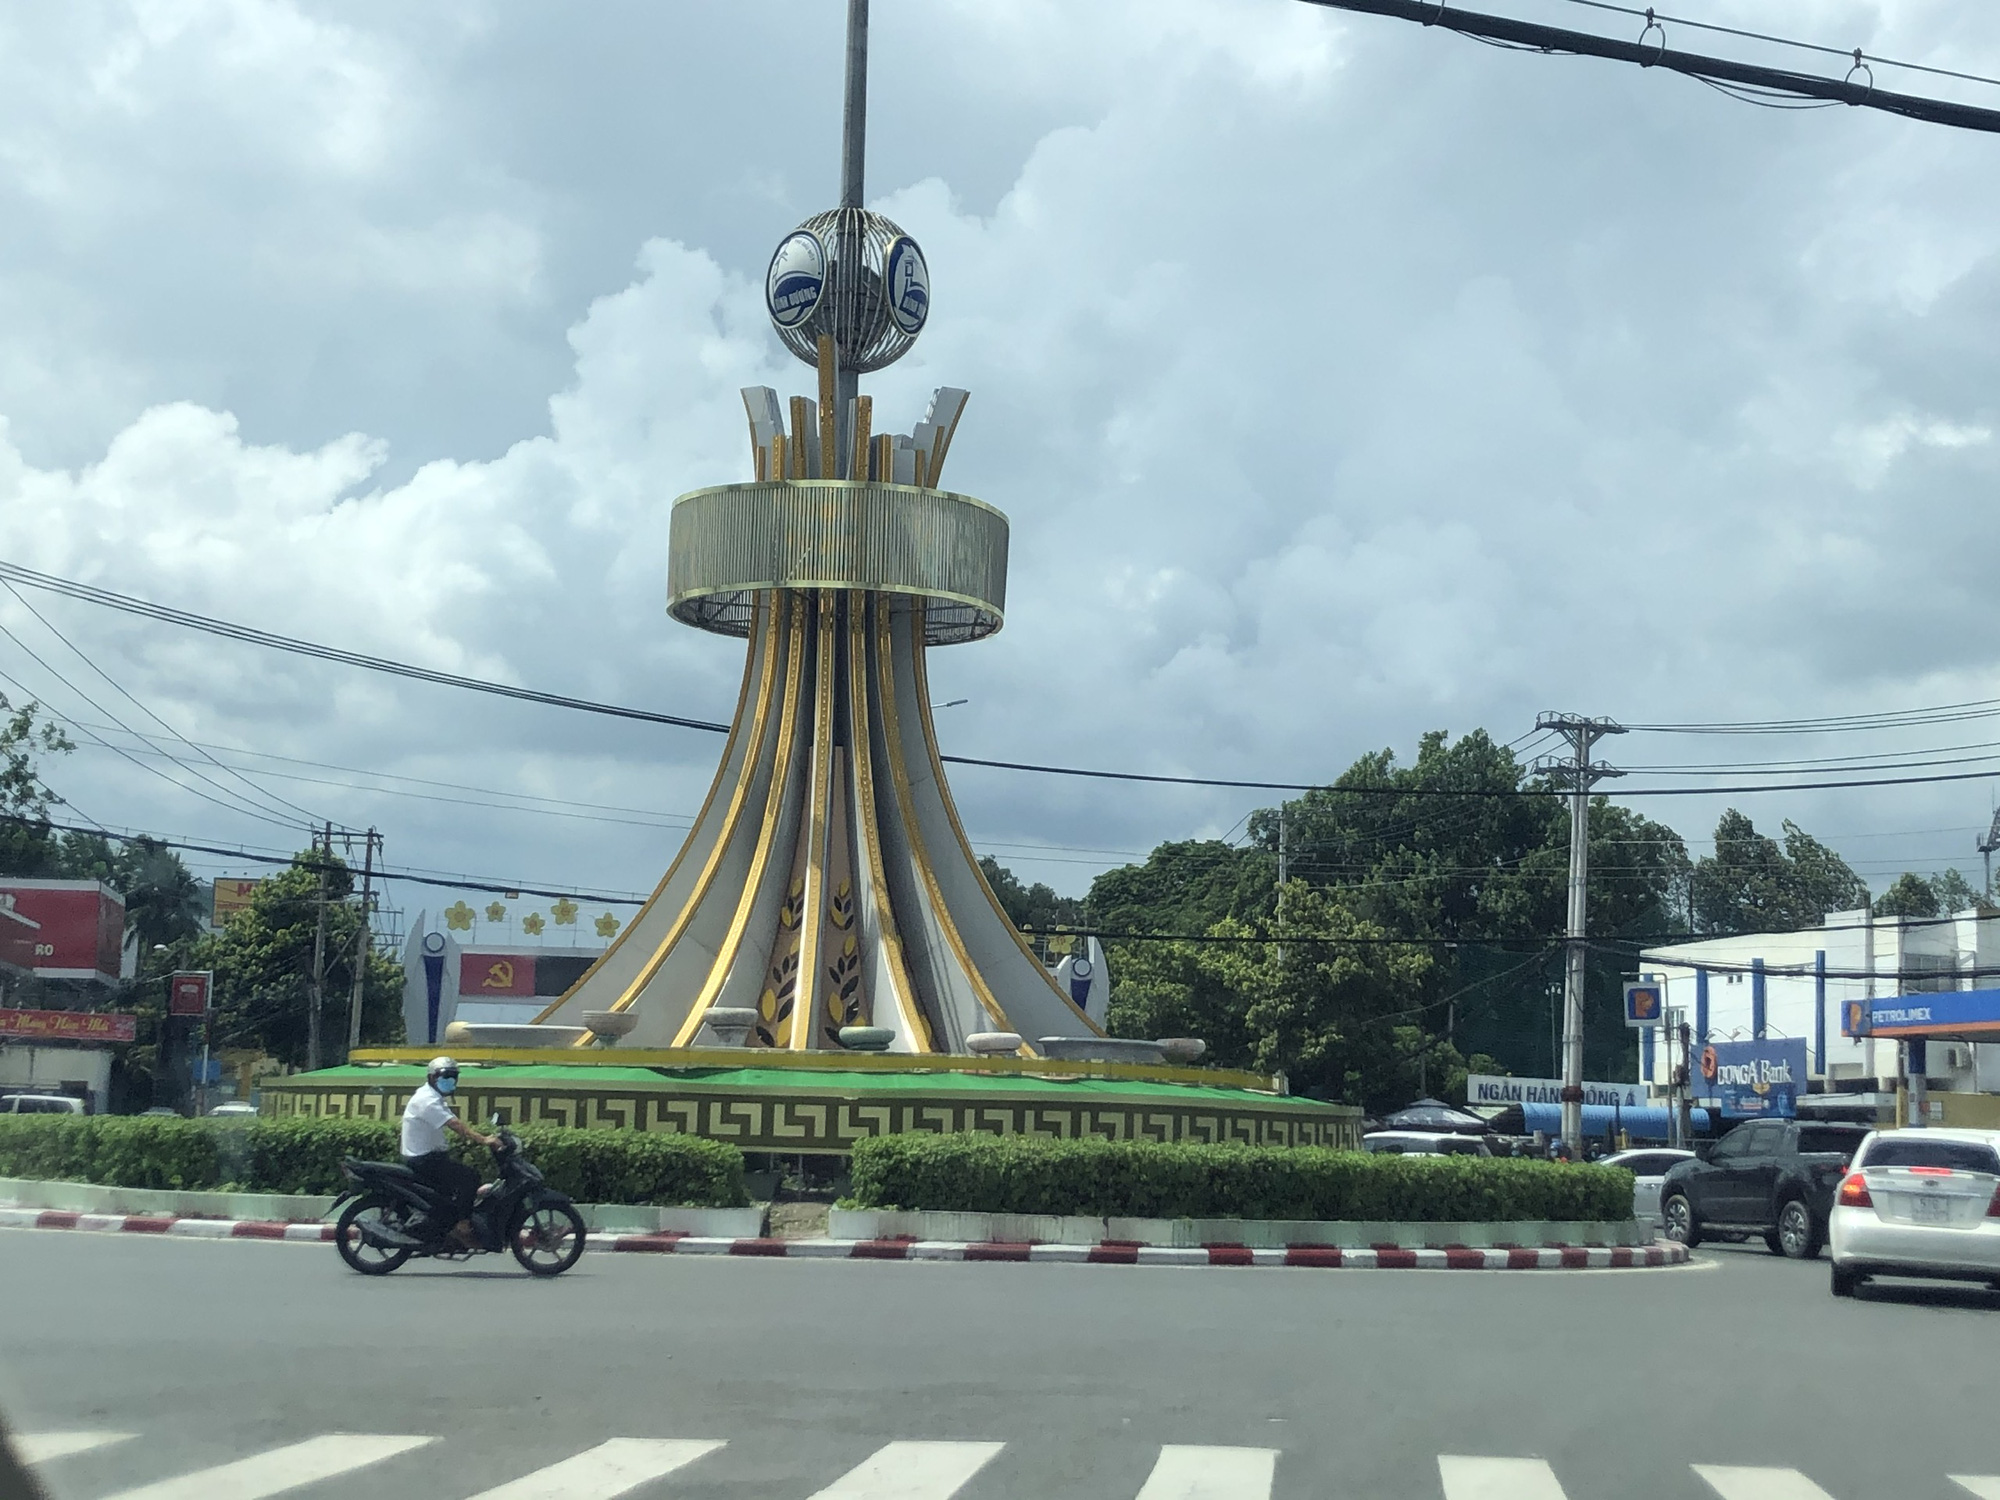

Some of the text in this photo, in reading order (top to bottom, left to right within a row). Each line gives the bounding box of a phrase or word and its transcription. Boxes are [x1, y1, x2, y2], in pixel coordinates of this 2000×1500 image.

[1872, 1008, 1932, 1023] PETROLIMEX
[1760, 1059, 1792, 1083] Bank
[1526, 1082, 1563, 1104] HÀN
[1581, 1085, 1620, 1106] ÔNG
